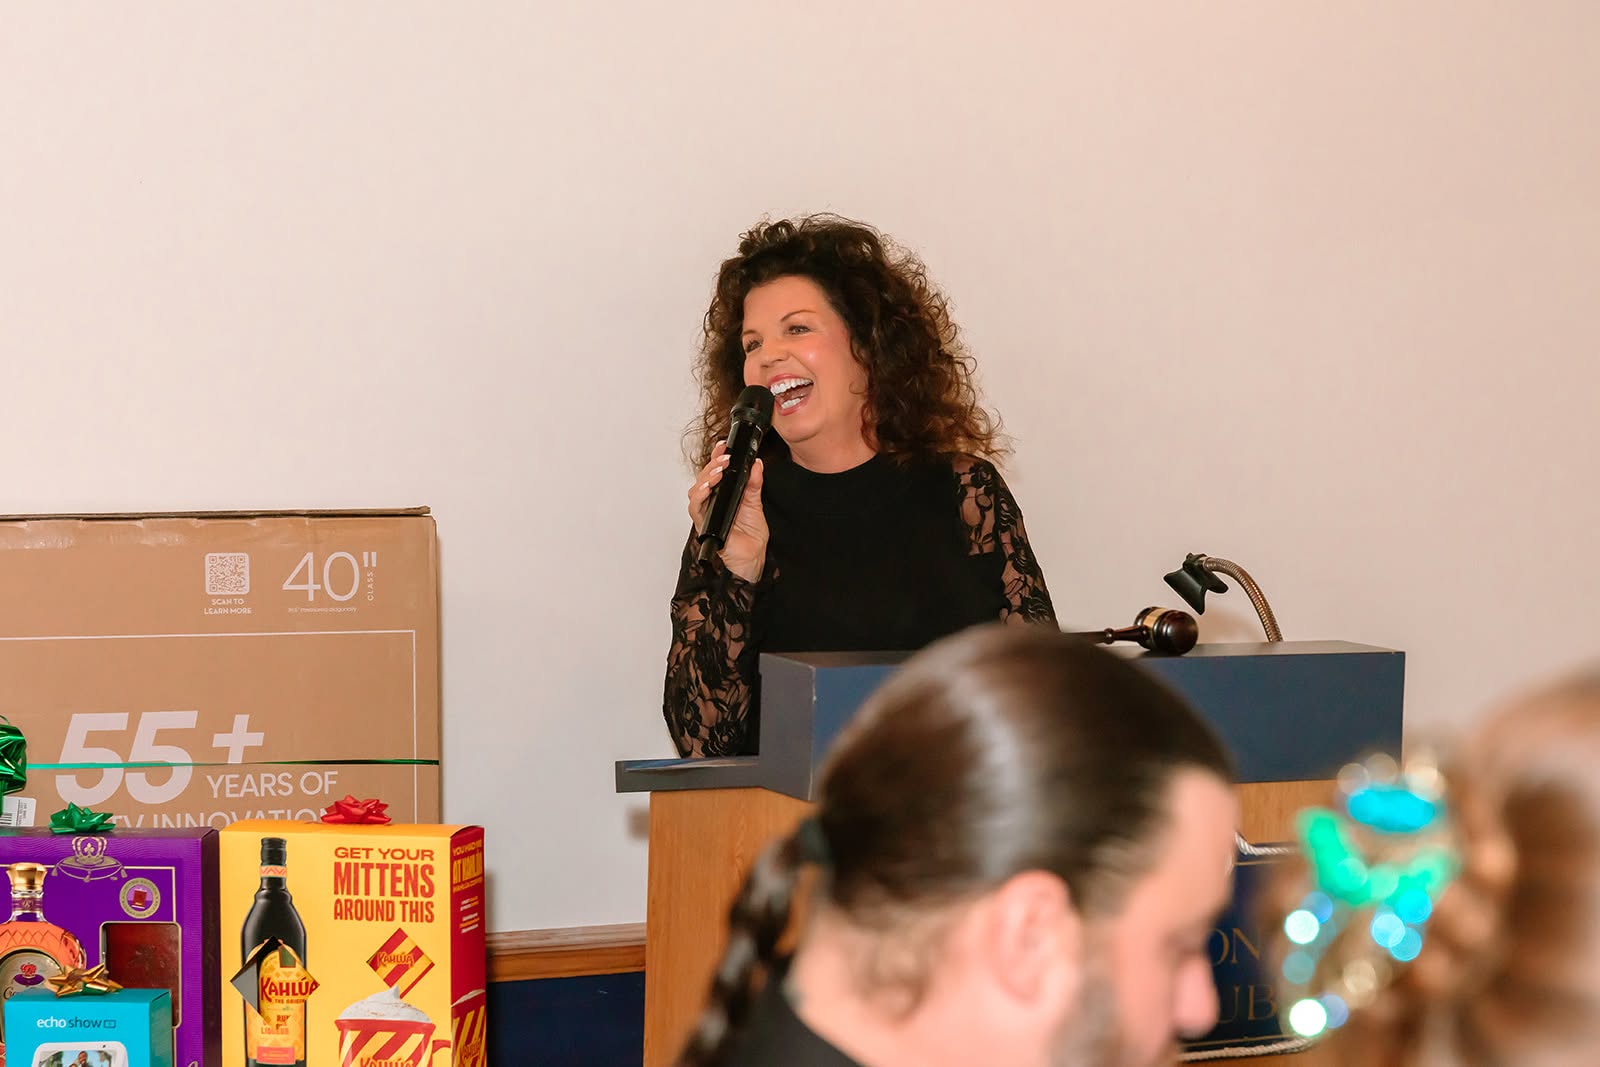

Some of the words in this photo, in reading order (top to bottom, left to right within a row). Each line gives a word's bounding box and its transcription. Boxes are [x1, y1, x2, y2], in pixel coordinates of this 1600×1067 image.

[282, 552, 377, 601] 40"
[207, 772, 293, 799] YEARS
[300, 771, 338, 796] OF
[153, 807, 328, 829] INNOVATIO
[334, 847, 374, 860] GET
[378, 848, 435, 861] YOUR
[333, 861, 435, 898] MITTENS
[333, 898, 395, 922] AROUND
[400, 900, 435, 923] THIS
[36, 1016, 67, 1029] echo
[68, 1016, 102, 1029] show
